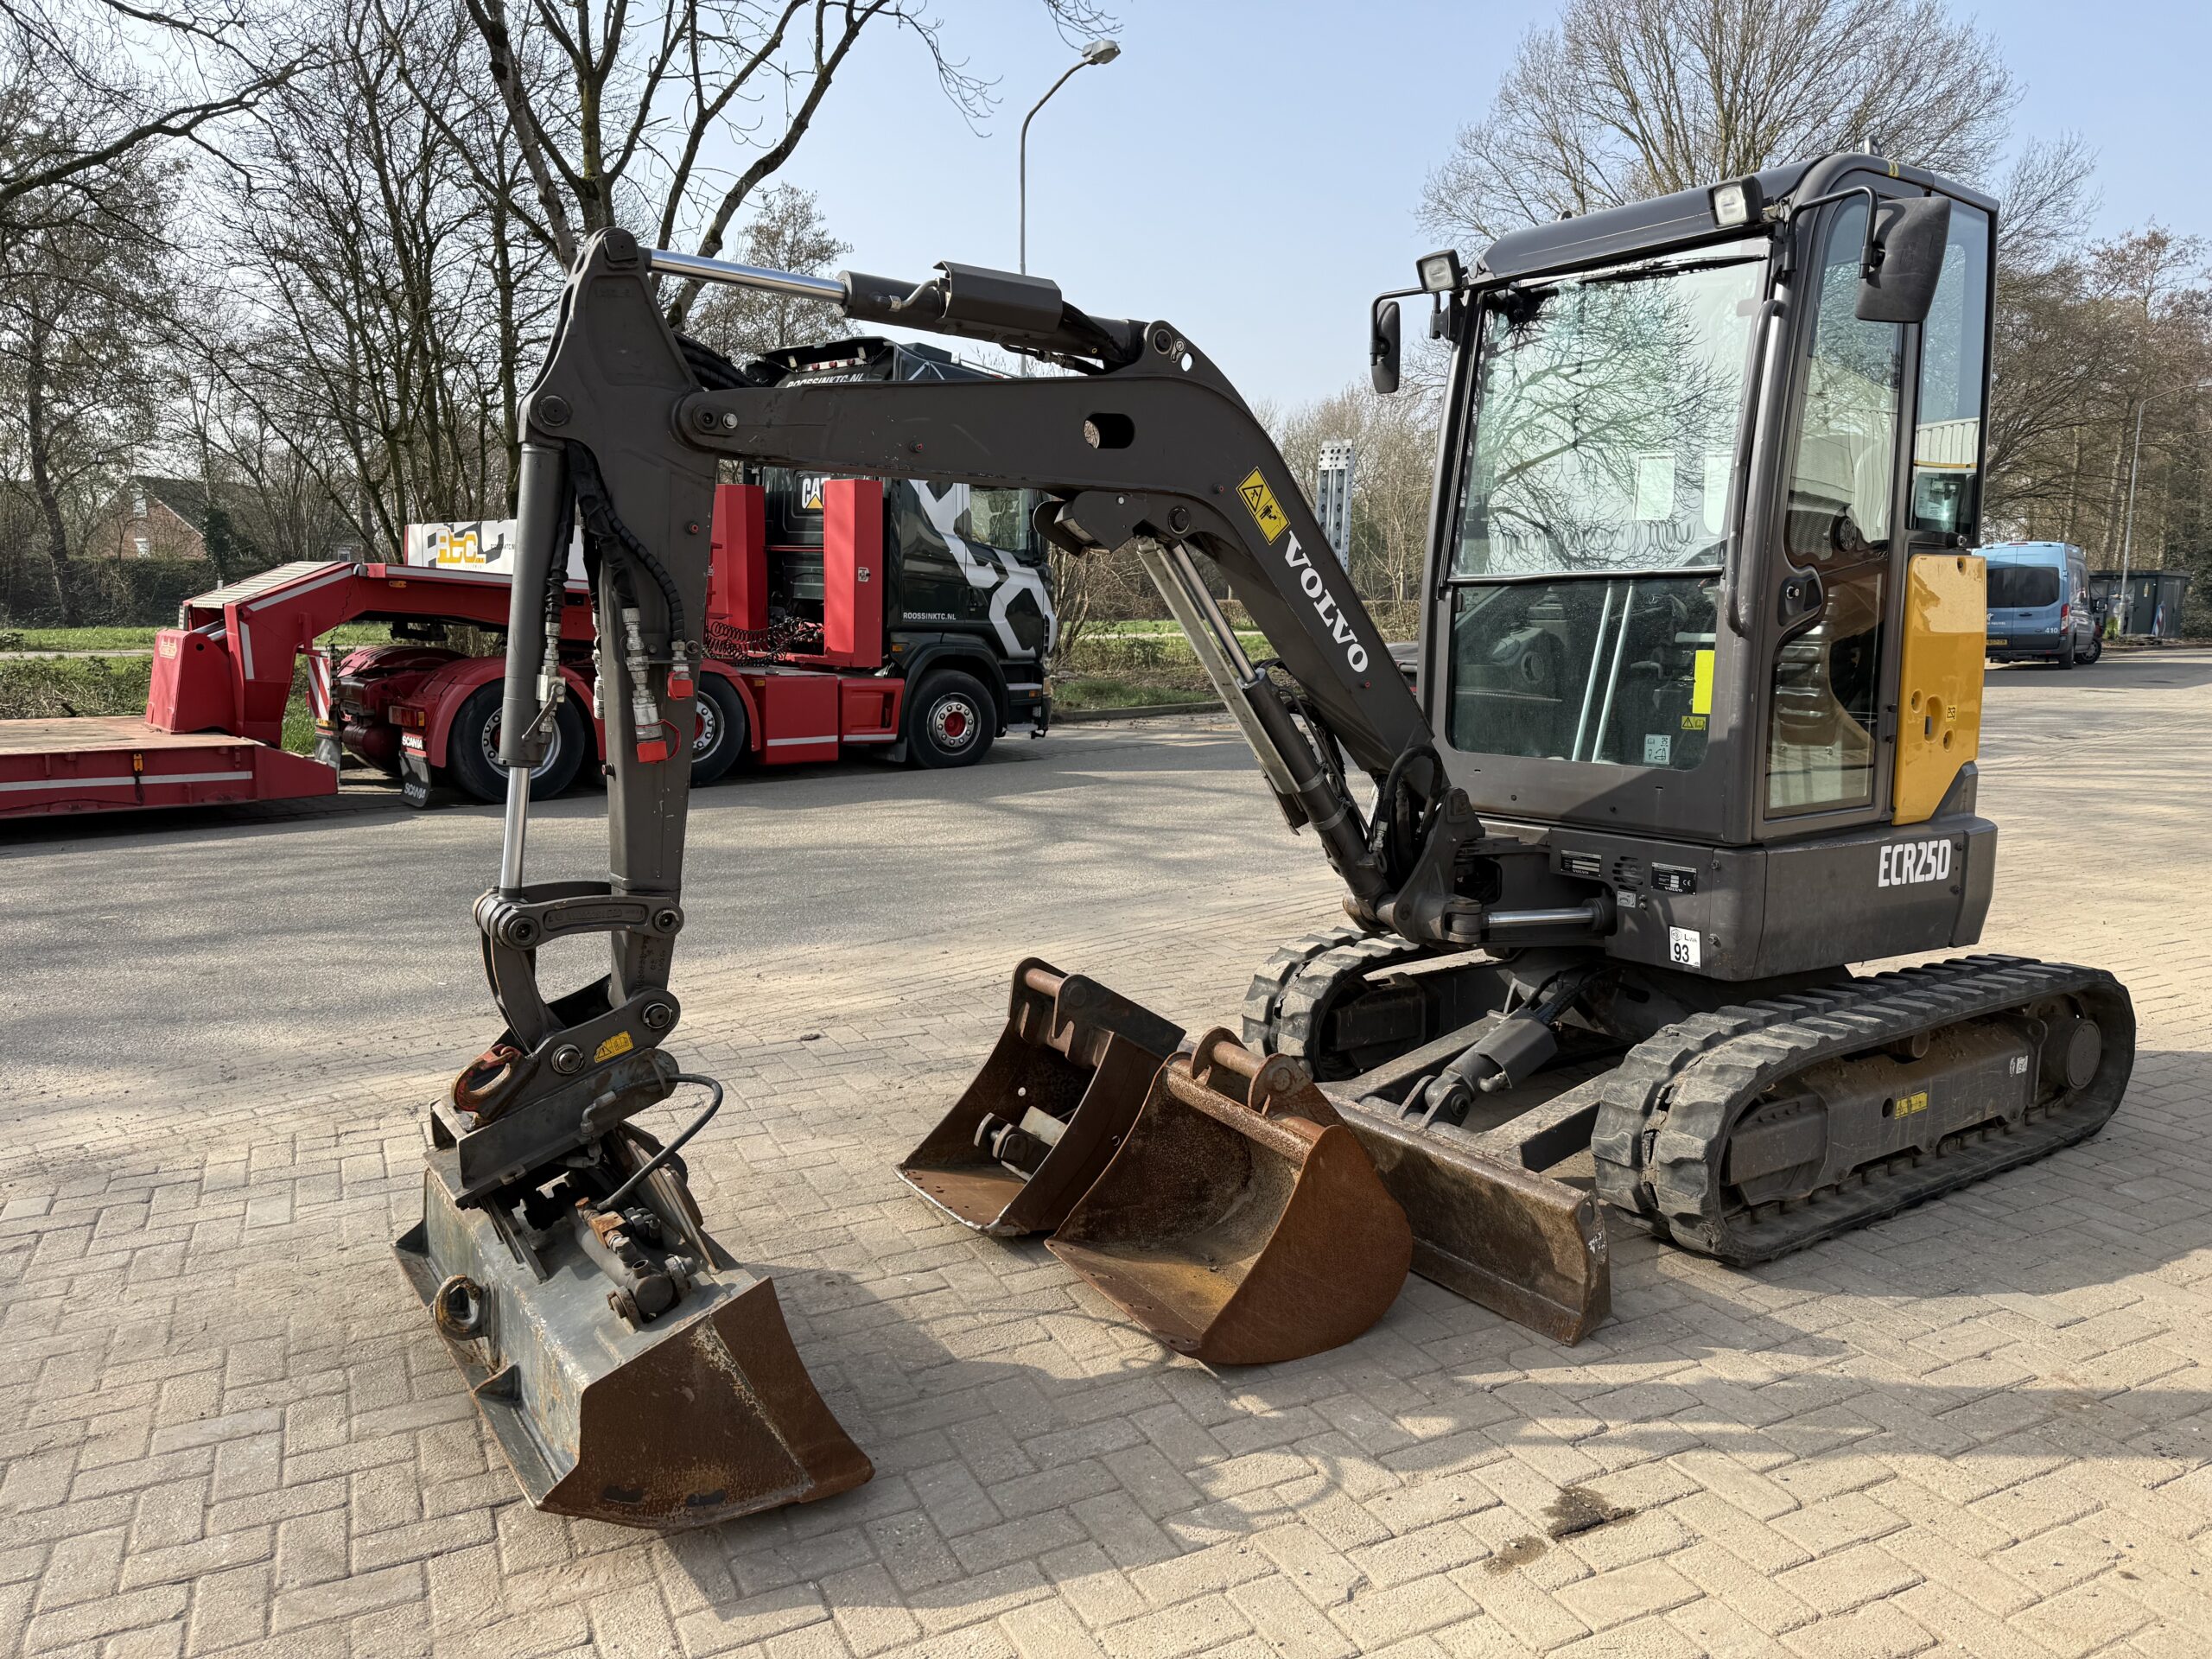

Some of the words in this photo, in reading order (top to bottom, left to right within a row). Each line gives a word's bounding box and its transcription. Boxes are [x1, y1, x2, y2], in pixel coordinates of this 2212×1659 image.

[1285, 530, 1369, 673] VOLVO
[903, 612, 957, 620] ROOSSINKTC.NL
[402, 735, 423, 749] SCANIA
[404, 782, 427, 799] SCANIA
[1878, 839, 1951, 887] ECR25D
[1674, 943, 1689, 963] 93
